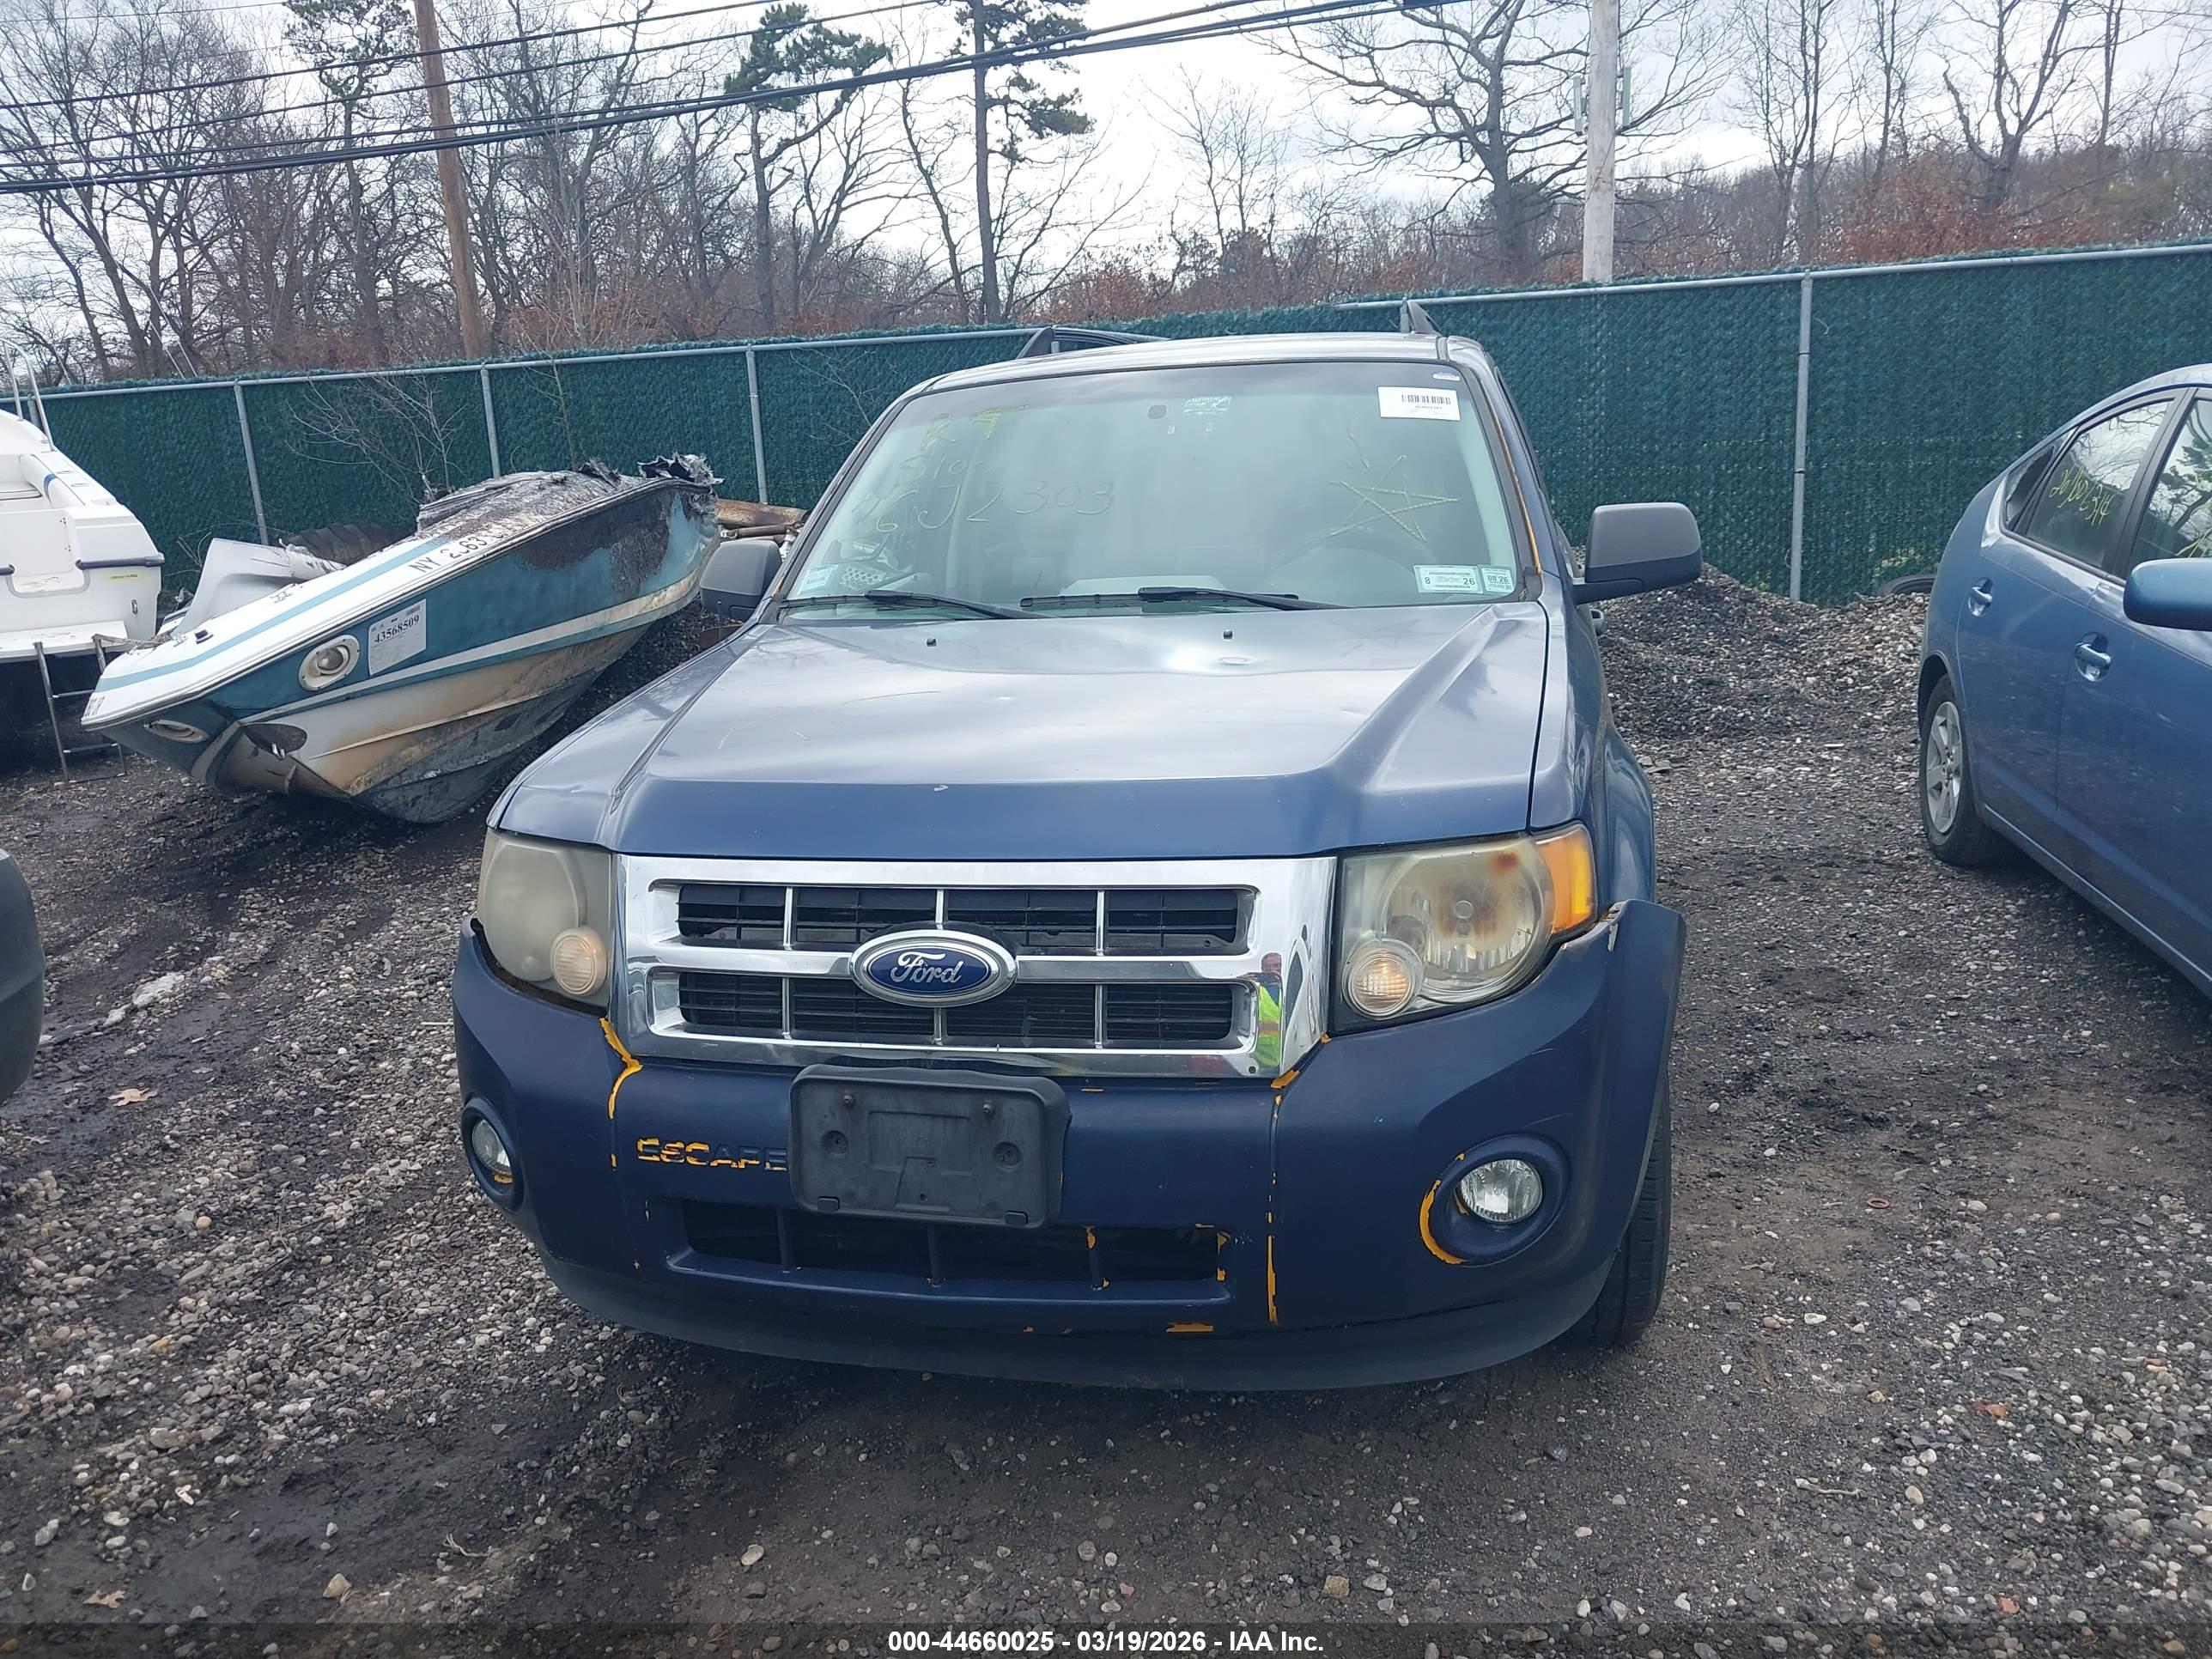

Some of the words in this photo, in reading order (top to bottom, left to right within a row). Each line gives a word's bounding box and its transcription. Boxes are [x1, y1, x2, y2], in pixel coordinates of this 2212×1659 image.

[409, 556, 441, 573] NY
[374, 615, 420, 643] 43568509
[890, 951, 965, 983] Ford
[636, 1137, 788, 1171] ESCAPE
